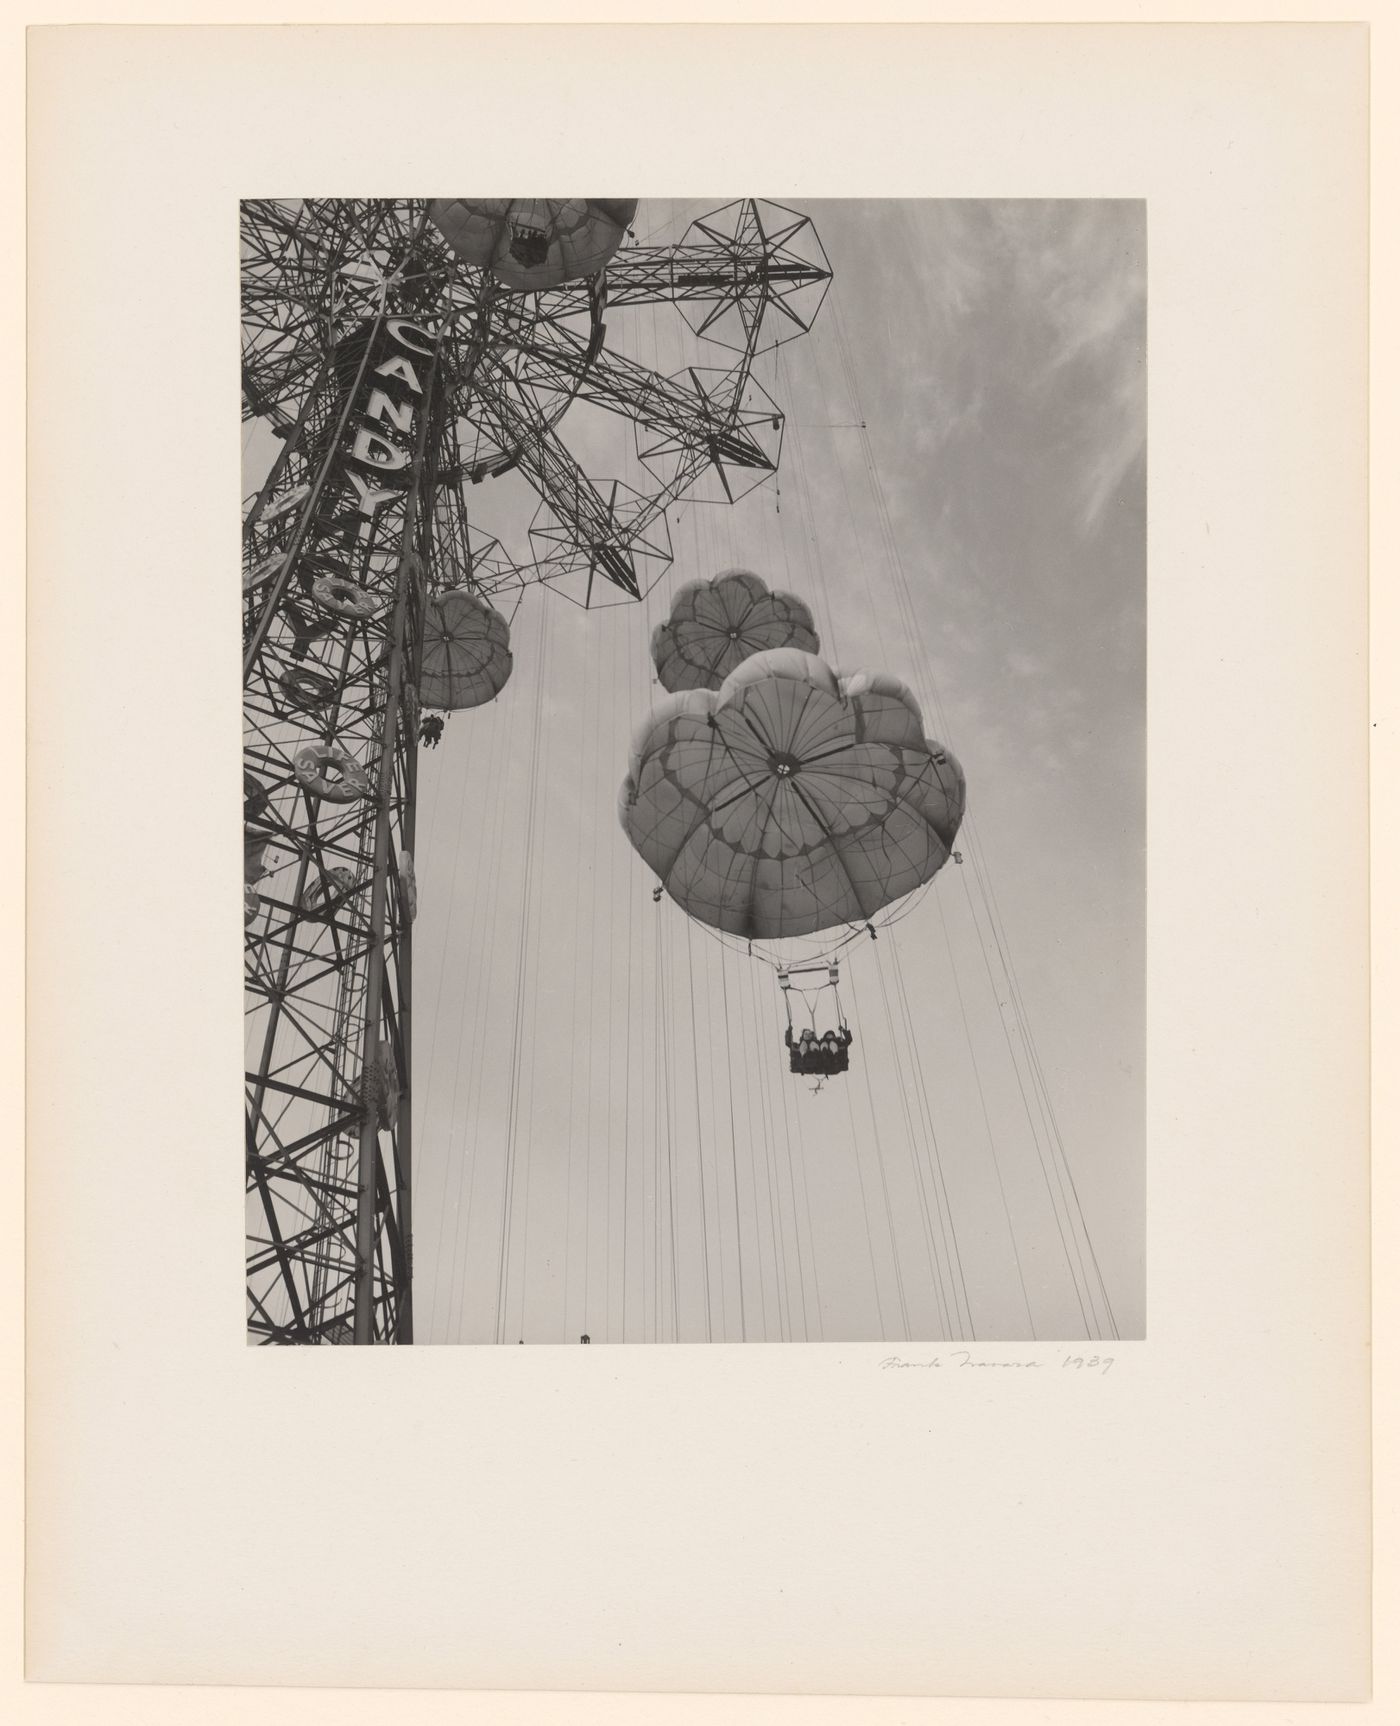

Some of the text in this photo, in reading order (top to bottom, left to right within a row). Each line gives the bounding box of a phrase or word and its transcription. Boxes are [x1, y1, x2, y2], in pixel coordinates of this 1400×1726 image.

[344, 319, 439, 517] CANDY
[309, 746, 364, 772] LIFE
[298, 759, 366, 796] SAVER
[1061, 1355, 1116, 1375] 1939
